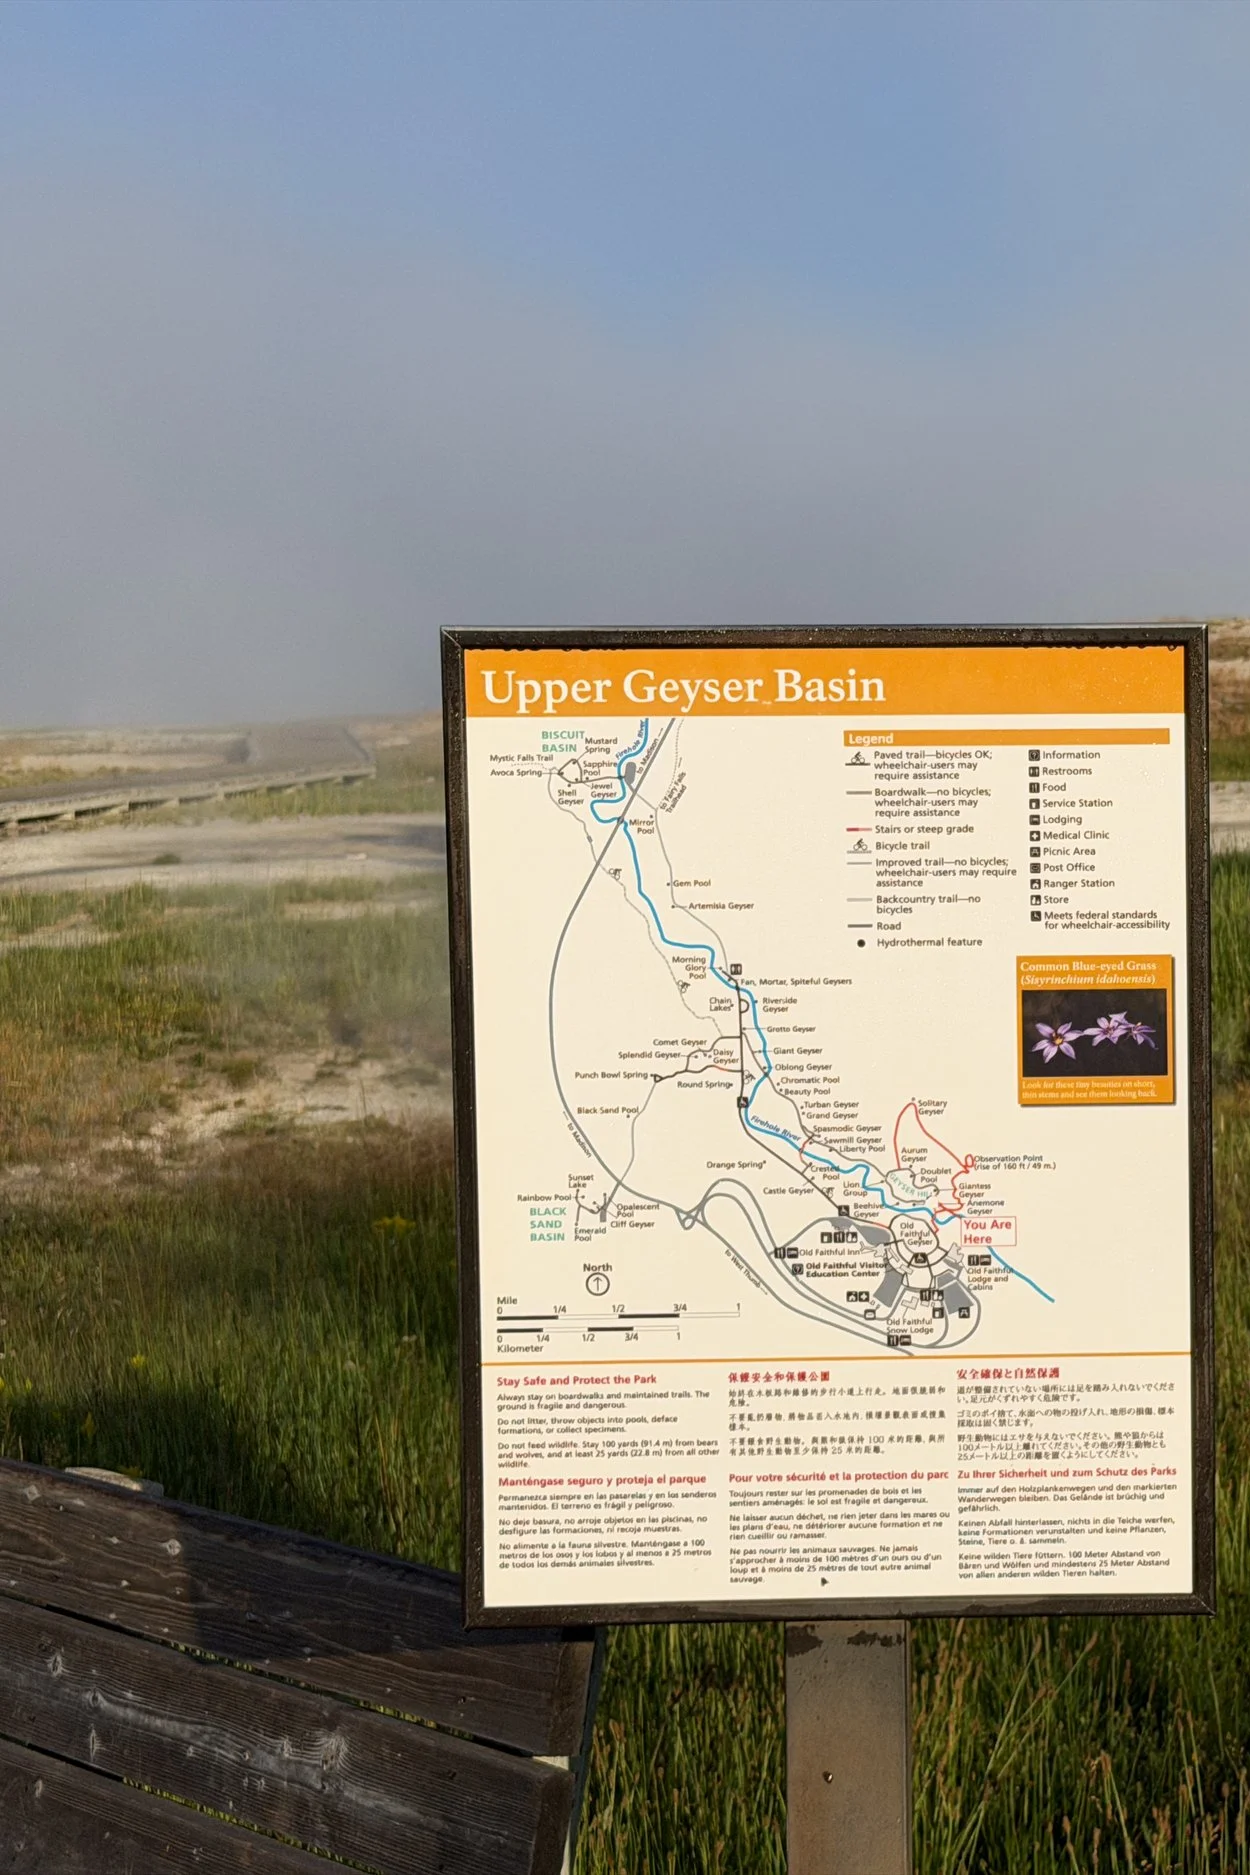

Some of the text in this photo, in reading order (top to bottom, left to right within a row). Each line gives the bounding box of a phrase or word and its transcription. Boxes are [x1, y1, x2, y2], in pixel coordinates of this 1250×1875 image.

[481, 668, 886, 713] Upper Geyser Basin
[541, 731, 586, 741] BISCUIT
[849, 733, 894, 746] Legend
[542, 744, 577, 753] BASIN
[585, 745, 611, 756] Spring
[874, 750, 903, 759] Paved
[974, 750, 992, 760] OK;
[1043, 750, 1101, 759] Information
[516, 769, 544, 778] Spring
[1042, 766, 1092, 776] Restrooms
[1042, 782, 1066, 792] Food
[1042, 798, 1113, 808] Service Station
[1043, 814, 1083, 826] Lodging
[875, 825, 902, 834] Stairs
[917, 825, 943, 835] steep
[946, 824, 974, 835] grade
[1043, 830, 1110, 840] Medical Clinic
[1043, 847, 1096, 856] Picnic Area
[1043, 862, 1095, 872] Post Office
[672, 879, 692, 889] Gem
[1044, 878, 1115, 890] Ranger Station
[1043, 895, 1069, 904] Store
[687, 902, 754, 912] Artemisia Geyser
[1044, 910, 1158, 920] Meets federal standards
[877, 921, 902, 931] Road
[1044, 920, 1170, 931] for wheelchair-accessibility
[877, 937, 983, 949] Hydrothermal feature
[672, 956, 706, 966] Morning
[685, 964, 706, 974] Glory
[1020, 960, 1157, 973] Common Blue-eyed Grass
[1020, 974, 1156, 987] (Sisyrinchium idahoensis)
[792, 1025, 816, 1034] Geyser
[796, 1047, 823, 1056] Geyser
[773, 1063, 832, 1072] Oblong Geyser
[623, 1071, 650, 1080] Spring
[600, 1106, 619, 1114] Sand
[622, 1106, 640, 1114] Pool
[832, 1111, 859, 1120] Geyser
[973, 1154, 1043, 1163] Observation Point
[530, 1207, 567, 1216] BLACK
[530, 1220, 562, 1229] SAND
[962, 1219, 1012, 1230] You Are
[530, 1233, 565, 1242] BASIN
[962, 1234, 992, 1244] Here
[583, 1263, 613, 1273] North
[806, 1262, 890, 1271] Old Faithful Visitor
[497, 1344, 544, 1353] Kilometer
[497, 1374, 657, 1388] Stay Safe and Protect the Park
[729, 1470, 949, 1483] Pour votre sécurité et la protection du parc
[957, 1470, 970, 1479] Zu
[972, 1470, 996, 1479] Ihrer
[999, 1468, 1047, 1479] Sicherheit
[1050, 1468, 1069, 1477] und
[1096, 1467, 1128, 1477] Schutz
[1131, 1467, 1148, 1476] des
[1150, 1466, 1177, 1476] Parks
[498, 1474, 706, 1488] Manténgase seguro y proteja el parque
